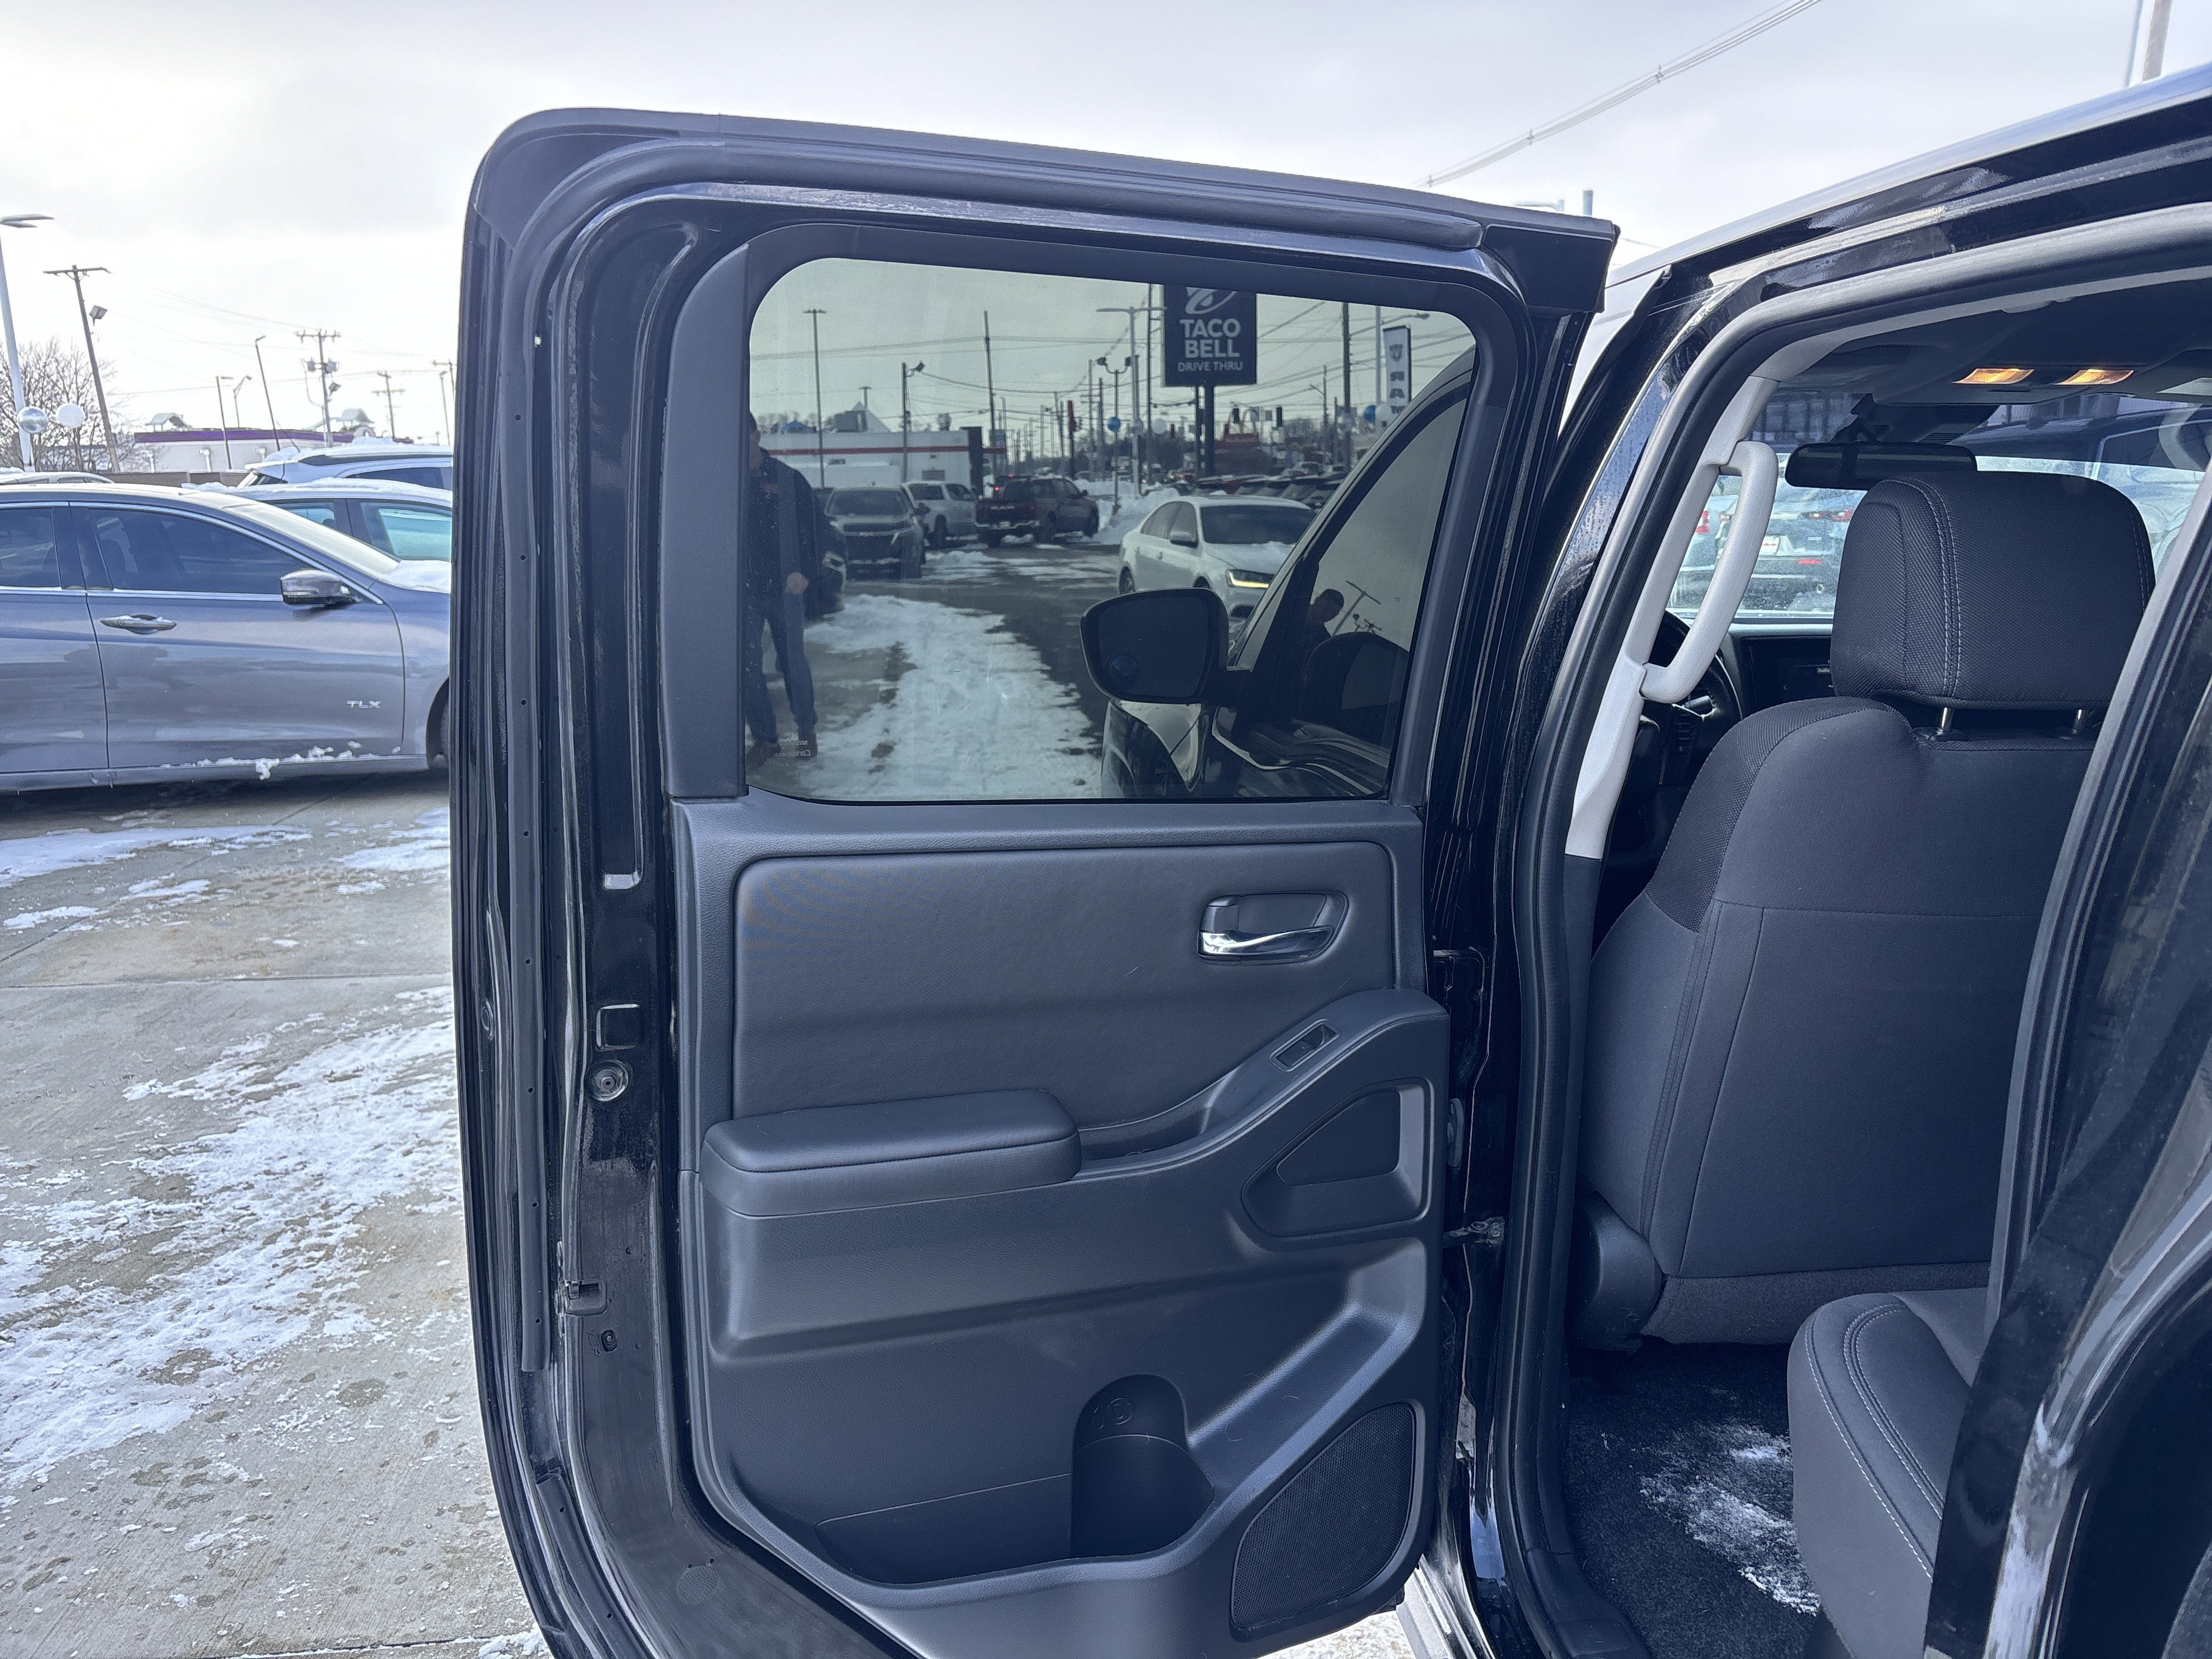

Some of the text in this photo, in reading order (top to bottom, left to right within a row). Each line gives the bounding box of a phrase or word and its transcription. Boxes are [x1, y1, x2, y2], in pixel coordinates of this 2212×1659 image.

[1180, 318, 1242, 338] TACO
[1184, 338, 1240, 358] BELL
[1177, 360, 1244, 372] DRIVE THRU
[347, 700, 381, 709] TLX
